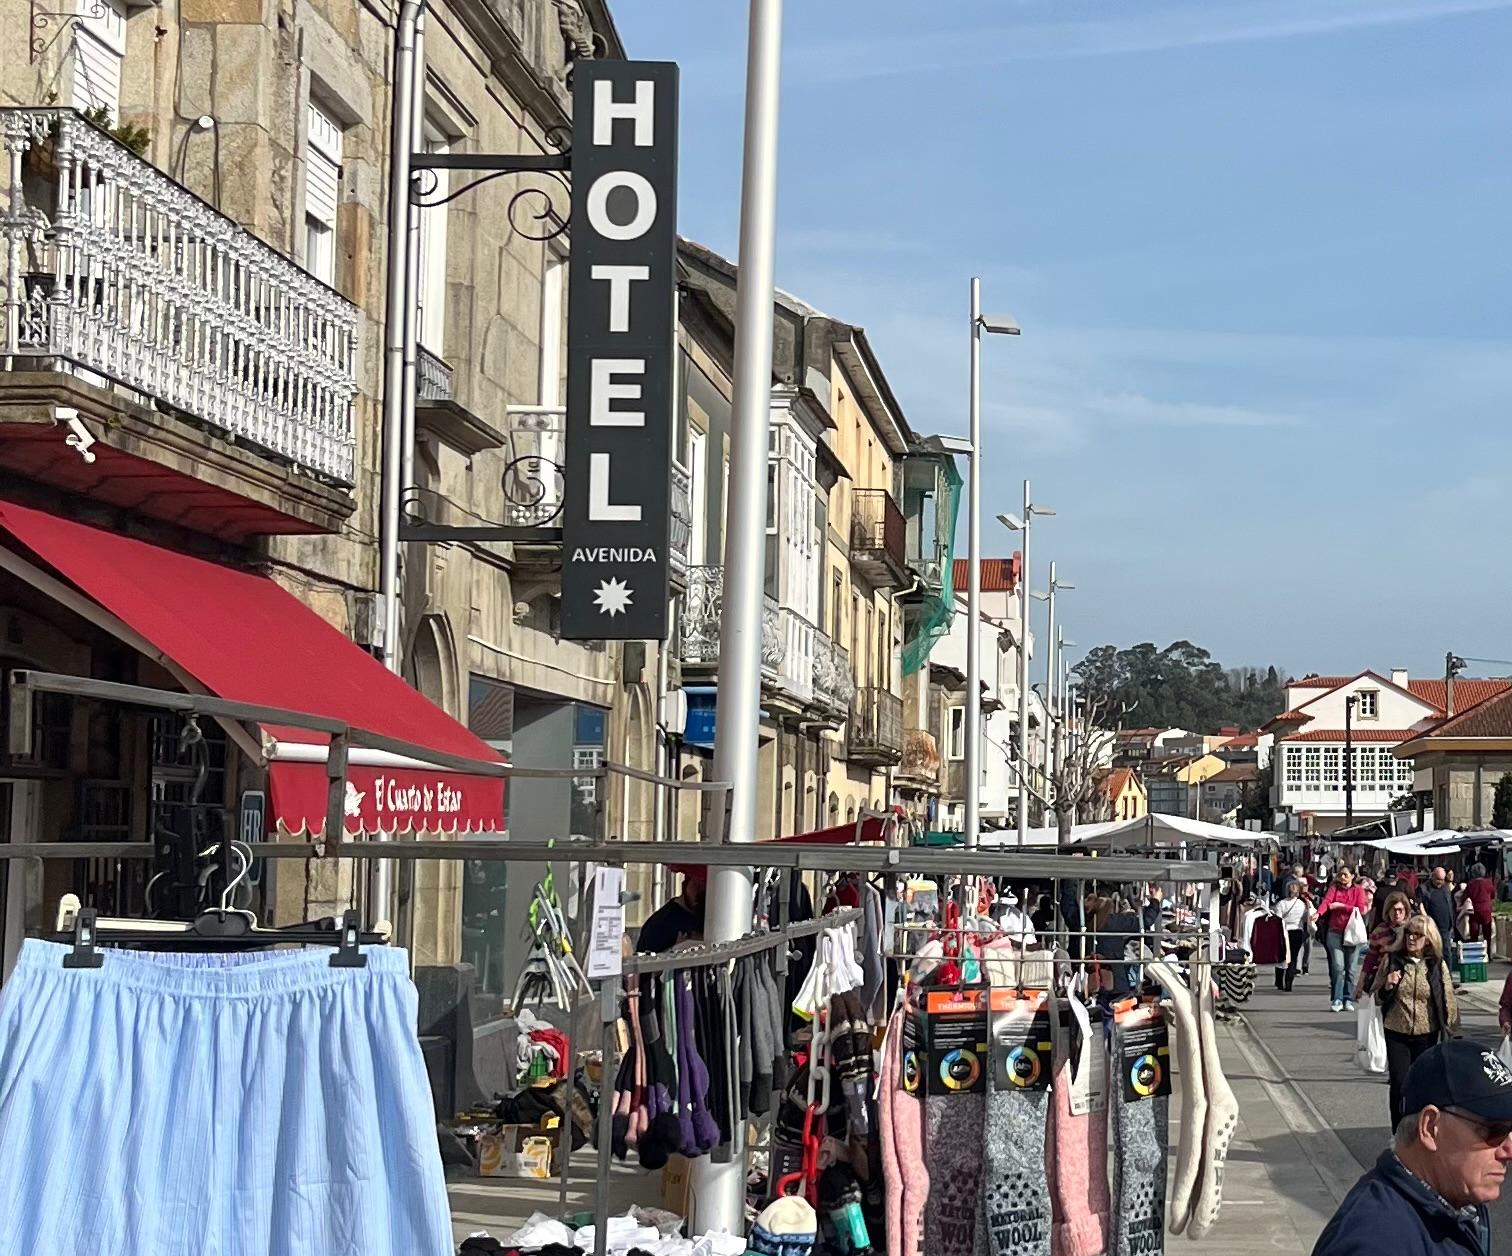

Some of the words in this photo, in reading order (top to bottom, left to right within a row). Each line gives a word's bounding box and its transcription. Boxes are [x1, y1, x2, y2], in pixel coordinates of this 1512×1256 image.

[586, 79, 657, 522] HOTEL
[572, 548, 657, 562] AVENIDA
[375, 775, 385, 812] El
[387, 779, 421, 812] Cuarto
[423, 783, 434, 812] de
[437, 782, 462, 812] Estar
[994, 1222, 1042, 1250] WOOL
[1127, 1230, 1161, 1256] WOOL
